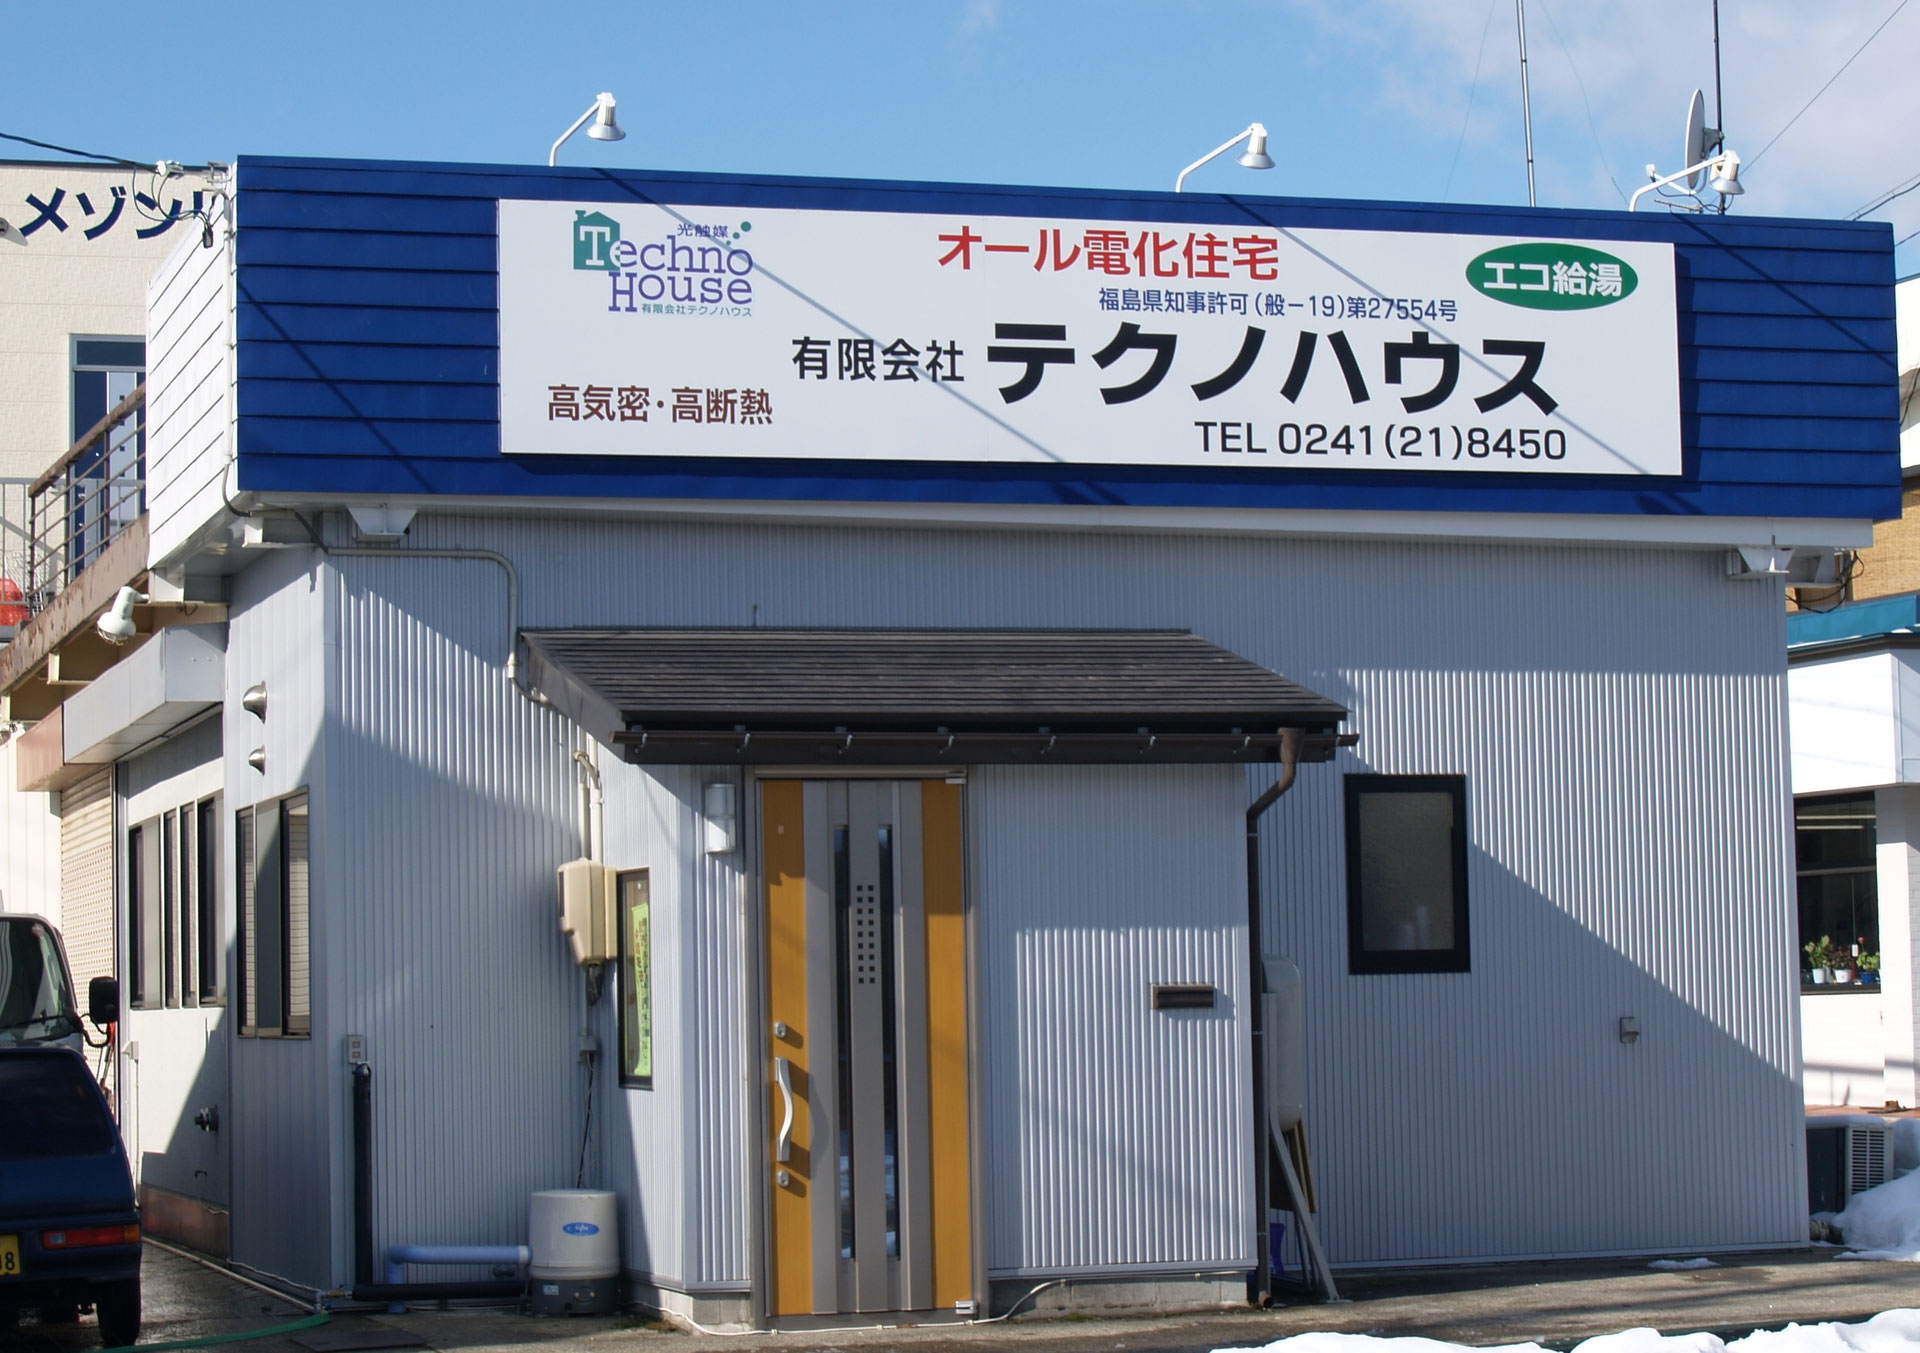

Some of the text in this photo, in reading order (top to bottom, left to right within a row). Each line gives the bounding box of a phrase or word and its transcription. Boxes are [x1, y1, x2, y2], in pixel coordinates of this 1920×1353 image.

[579, 225, 754, 276] Techno
[677, 223, 729, 238] 光触媒
[938, 225, 1279, 281] オール電化住宅
[608, 271, 753, 313] House
[1483, 261, 1624, 298] エコ給湯
[641, 303, 752, 317] 有限会社テクノハウス
[792, 321, 1559, 415] 有限会社 テクノハウス
[1194, 421, 1566, 461] TEL 0241(21)8450
